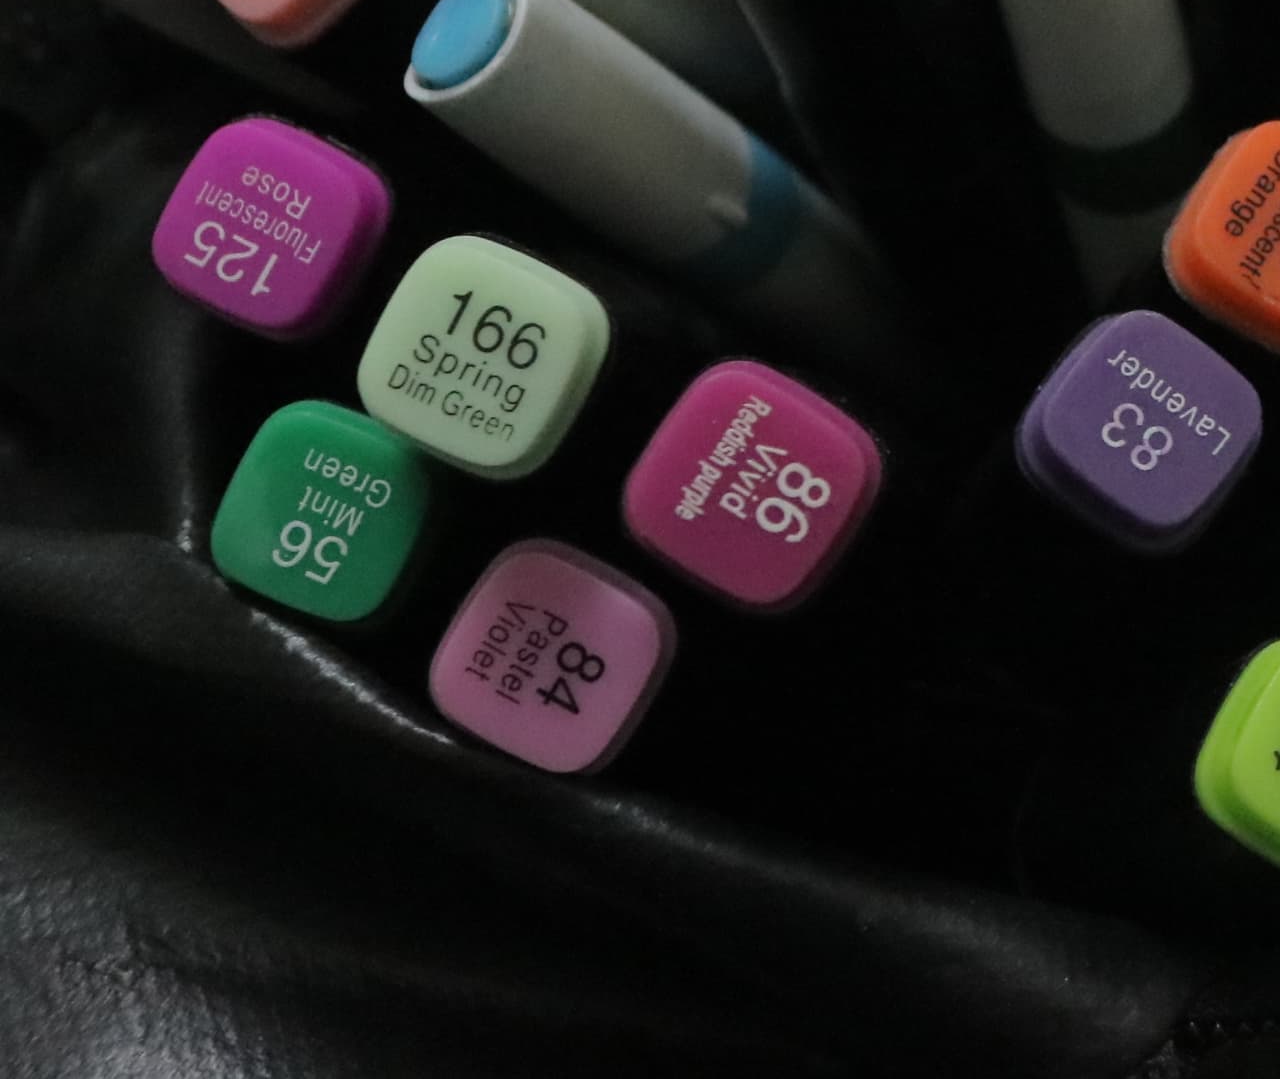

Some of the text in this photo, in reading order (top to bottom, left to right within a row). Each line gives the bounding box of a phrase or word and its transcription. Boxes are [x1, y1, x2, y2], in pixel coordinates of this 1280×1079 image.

[197, 181, 322, 265] Fluorescent
[240, 164, 312, 220] Rose
[184, 219, 279, 296] 125
[446, 288, 548, 371] 166
[387, 363, 516, 443] Dim Green
[412, 333, 527, 414] Spring
[1105, 348, 1234, 456] Lavender
[674, 394, 774, 521] Reddish purple
[1100, 402, 1174, 472] 83
[298, 485, 365, 537] Mint
[302, 447, 393, 509] Green
[720, 443, 790, 520] Vivid
[755, 462, 832, 544] 86
[271, 520, 350, 585] 56
[465, 600, 537, 682] Violet
[494, 607, 570, 704] Pastel
[535, 640, 606, 715] 84
